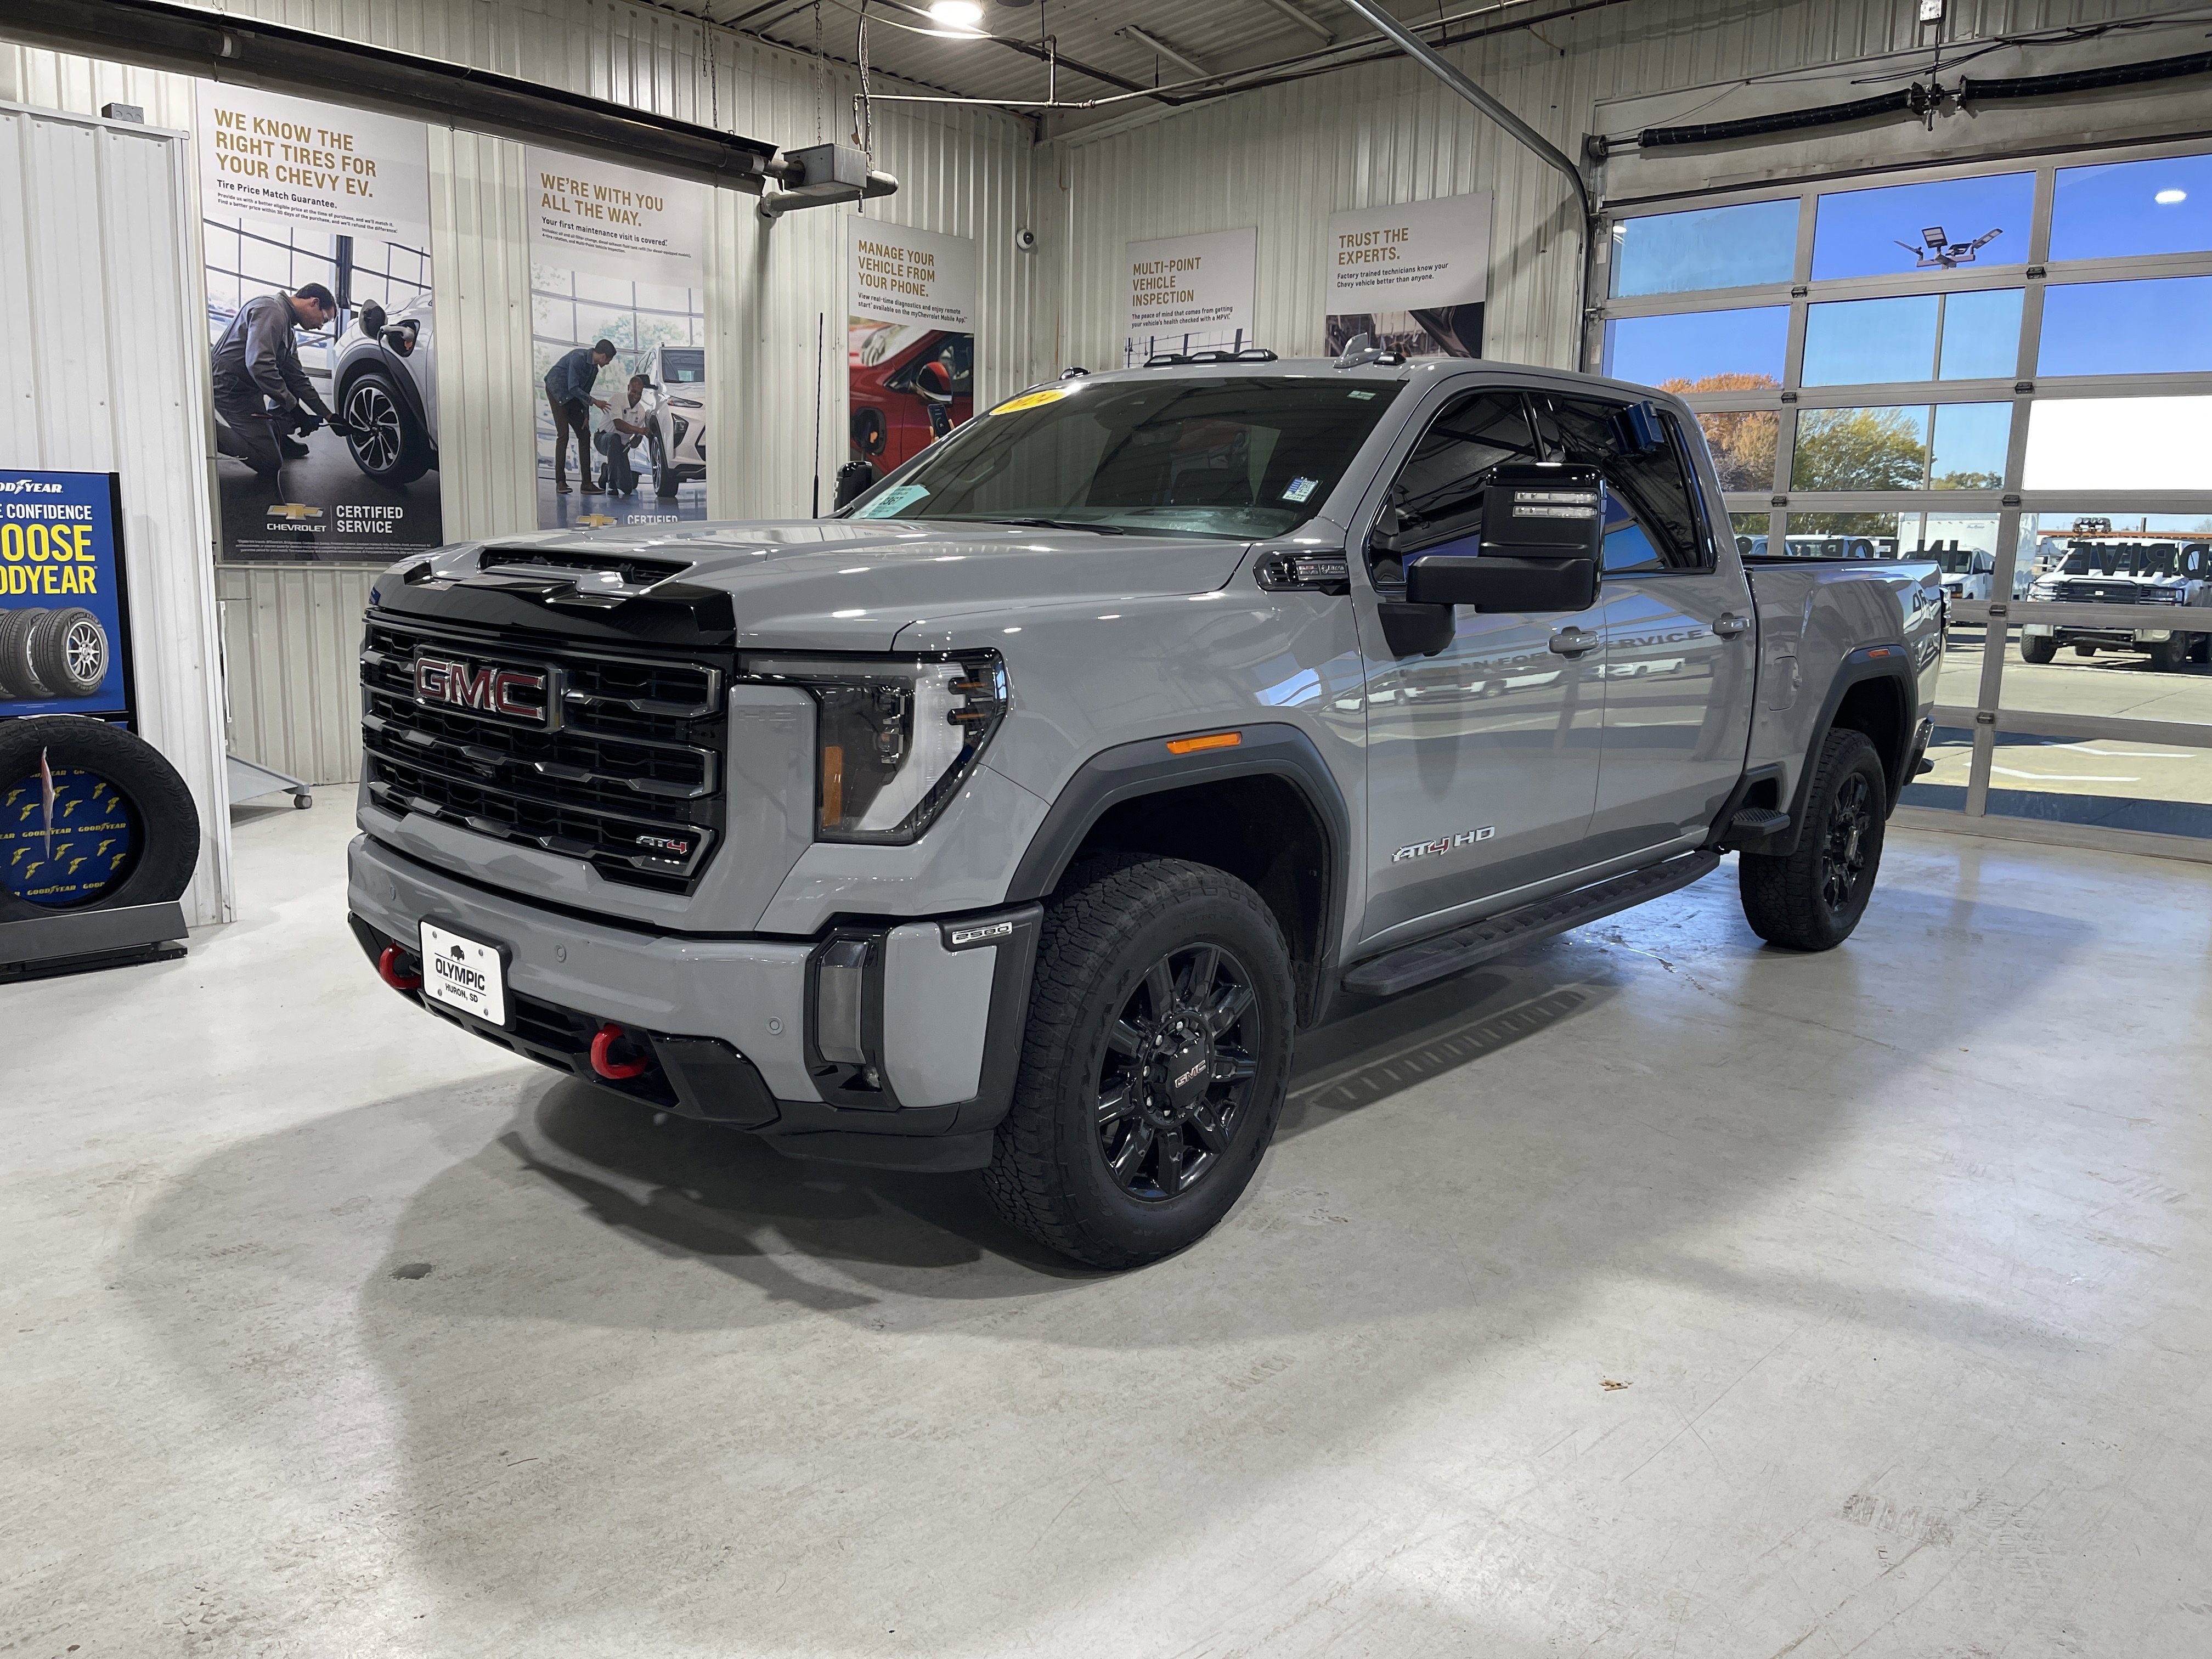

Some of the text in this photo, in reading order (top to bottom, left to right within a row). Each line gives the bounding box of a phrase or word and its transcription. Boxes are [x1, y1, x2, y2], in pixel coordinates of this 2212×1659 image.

[215, 109, 353, 151] WE KNOW THE
[216, 131, 376, 177] RIGHT TIRES FOR
[216, 153, 373, 198] YOUR CHEVY EV.
[217, 179, 337, 209] Tire Price Match Guarantee.
[541, 173, 663, 211] WE'RE WITH YOU
[541, 193, 641, 227] ALL THE WAY.
[542, 217, 557, 226] Your
[560, 220, 574, 230] first
[576, 223, 617, 239] maintenance
[1339, 228, 1408, 248] TRUST THE
[859, 240, 934, 266] MANAGE YOUR
[1339, 247, 1400, 265] EXPERTS.
[859, 256, 934, 282] VEHICLE FROM
[1133, 257, 1201, 275] MULTI-POINT
[1338, 272, 1359, 280] Factory
[1361, 269, 1380, 277] trained
[1383, 267, 1415, 275] technicians
[1435, 263, 1448, 272] your
[859, 272, 928, 297] YOUR PHONE.
[1133, 275, 1176, 291] VEHICLE
[1377, 276, 1394, 285] better
[1412, 274, 1434, 283] anyone.
[871, 296, 893, 304] real-time
[895, 300, 921, 309] diagnostics
[1133, 290, 1194, 306] INSPECTION
[873, 304, 894, 313] available
[911, 311, 939, 320] myChevrolet
[1215, 306, 1233, 314] getting
[7, 504, 92, 520] CONFIDENCE
[336, 505, 403, 519] CERTIFIED
[267, 523, 326, 532] CHEVROLET
[337, 520, 392, 533] SERVICE
[1, 523, 95, 561] OOSE
[416, 657, 546, 721] GMC
[79, 822, 126, 832] GOODYEAR
[636, 835, 688, 854] AT4
[1392, 825, 1496, 862] AT4 HD
[27, 885, 76, 895] GOODYEAR
[956, 925, 1010, 940] 2500
[436, 958, 485, 991] OLYMPIC
[445, 983, 478, 1003] HURON, SD
[1174, 1059, 1207, 1088] GMC
